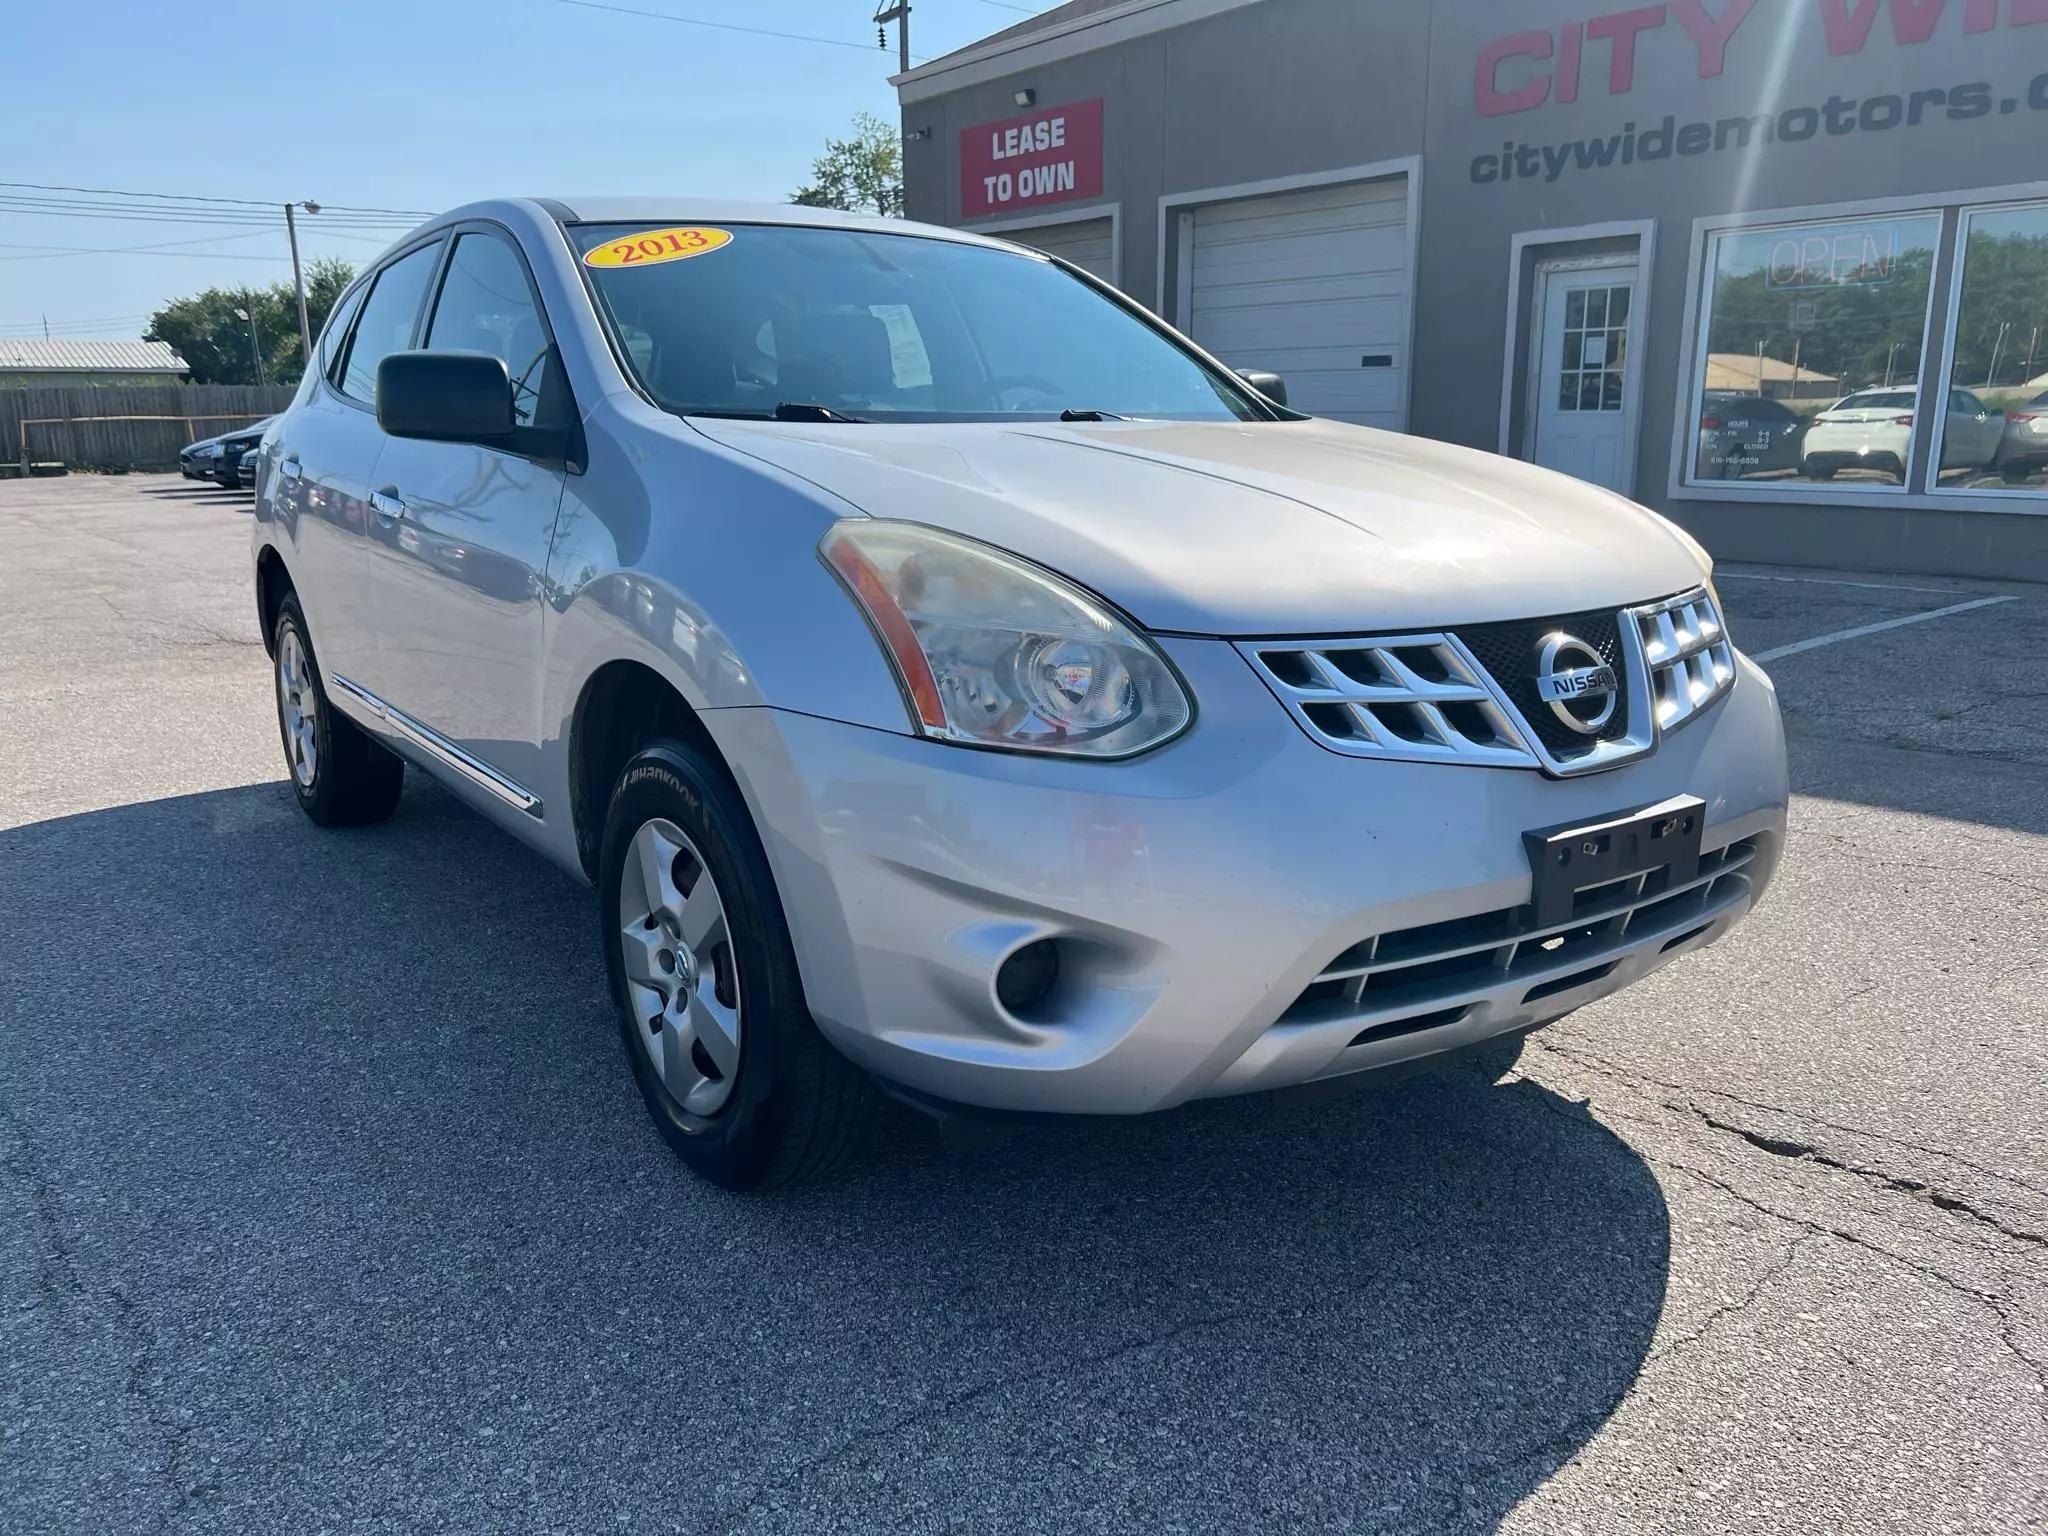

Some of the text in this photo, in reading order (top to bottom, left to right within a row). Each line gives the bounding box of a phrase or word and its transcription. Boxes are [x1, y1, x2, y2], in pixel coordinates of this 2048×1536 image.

[1474, 0, 1760, 117] CITY
[992, 117, 1065, 160] LEASE
[984, 160, 1075, 204] TO OWN
[612, 230, 708, 264] 2013
[1771, 230, 1894, 284] OPEN
[1552, 672, 1616, 694] NISSAN
